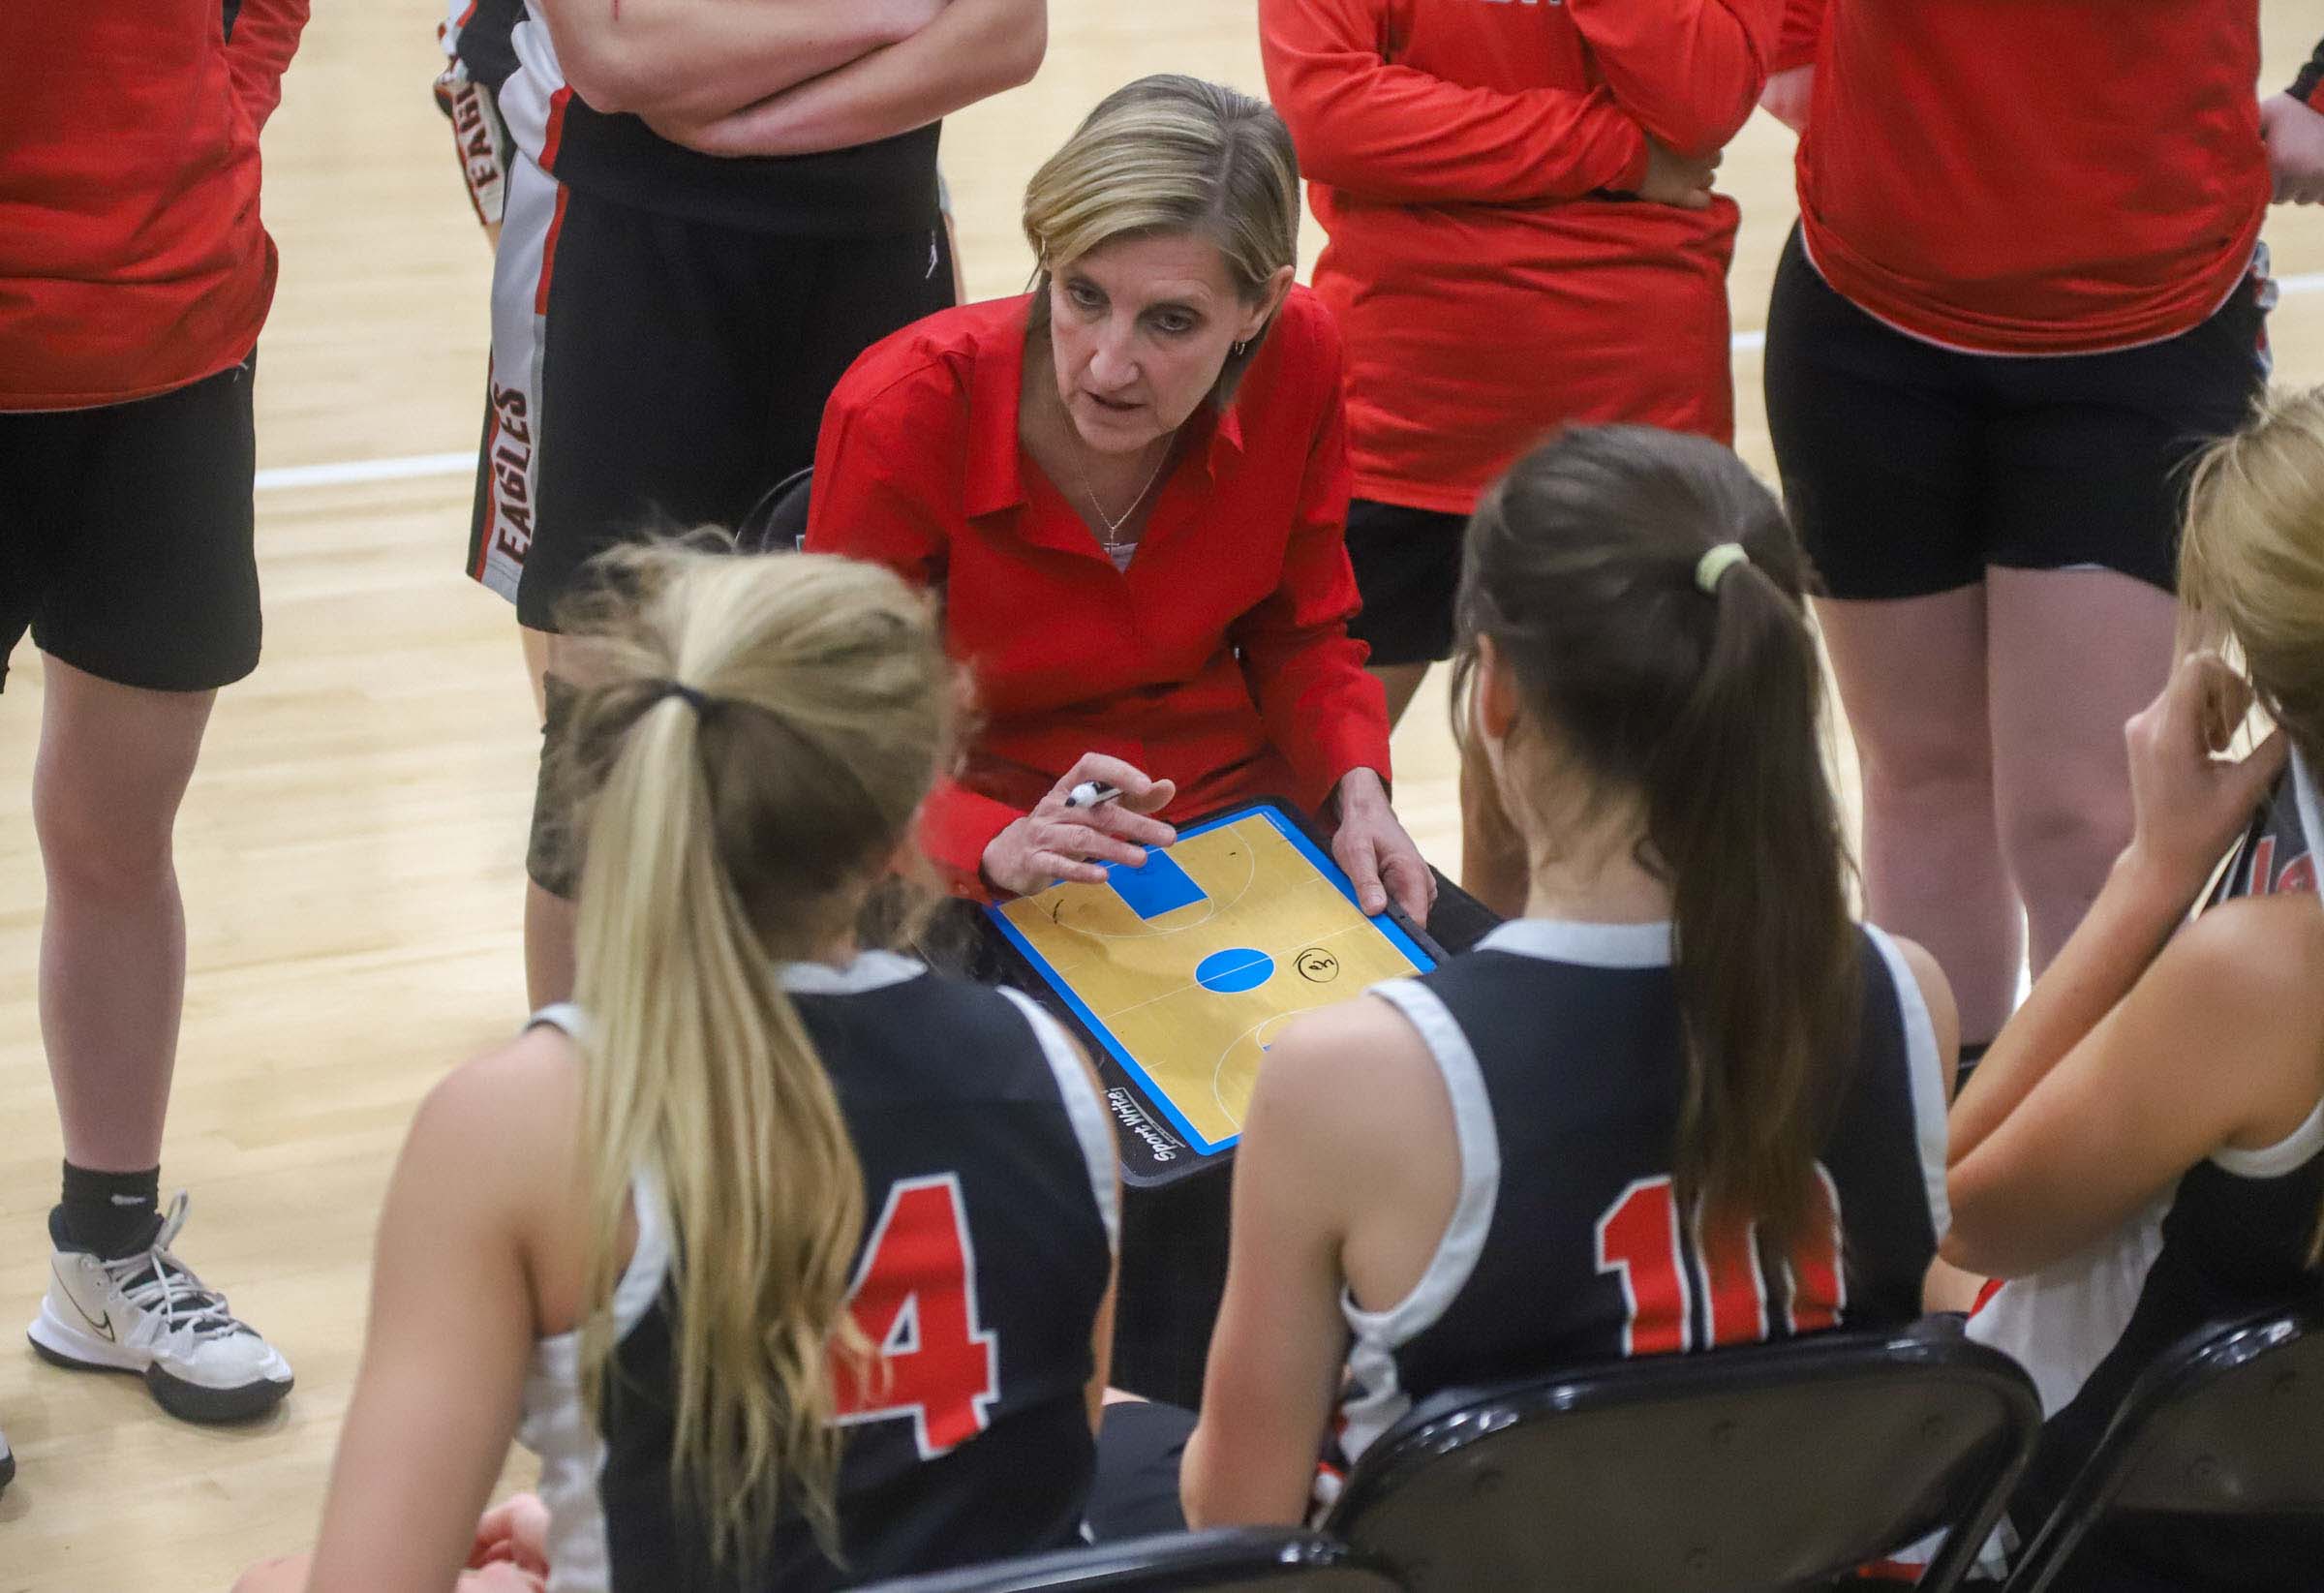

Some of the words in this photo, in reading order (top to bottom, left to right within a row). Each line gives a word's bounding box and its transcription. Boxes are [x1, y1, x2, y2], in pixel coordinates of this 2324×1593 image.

[493, 382, 532, 565] EAGLES
[1134, 1124, 1177, 1162] Sport
[828, 1171, 1001, 1461] 4
